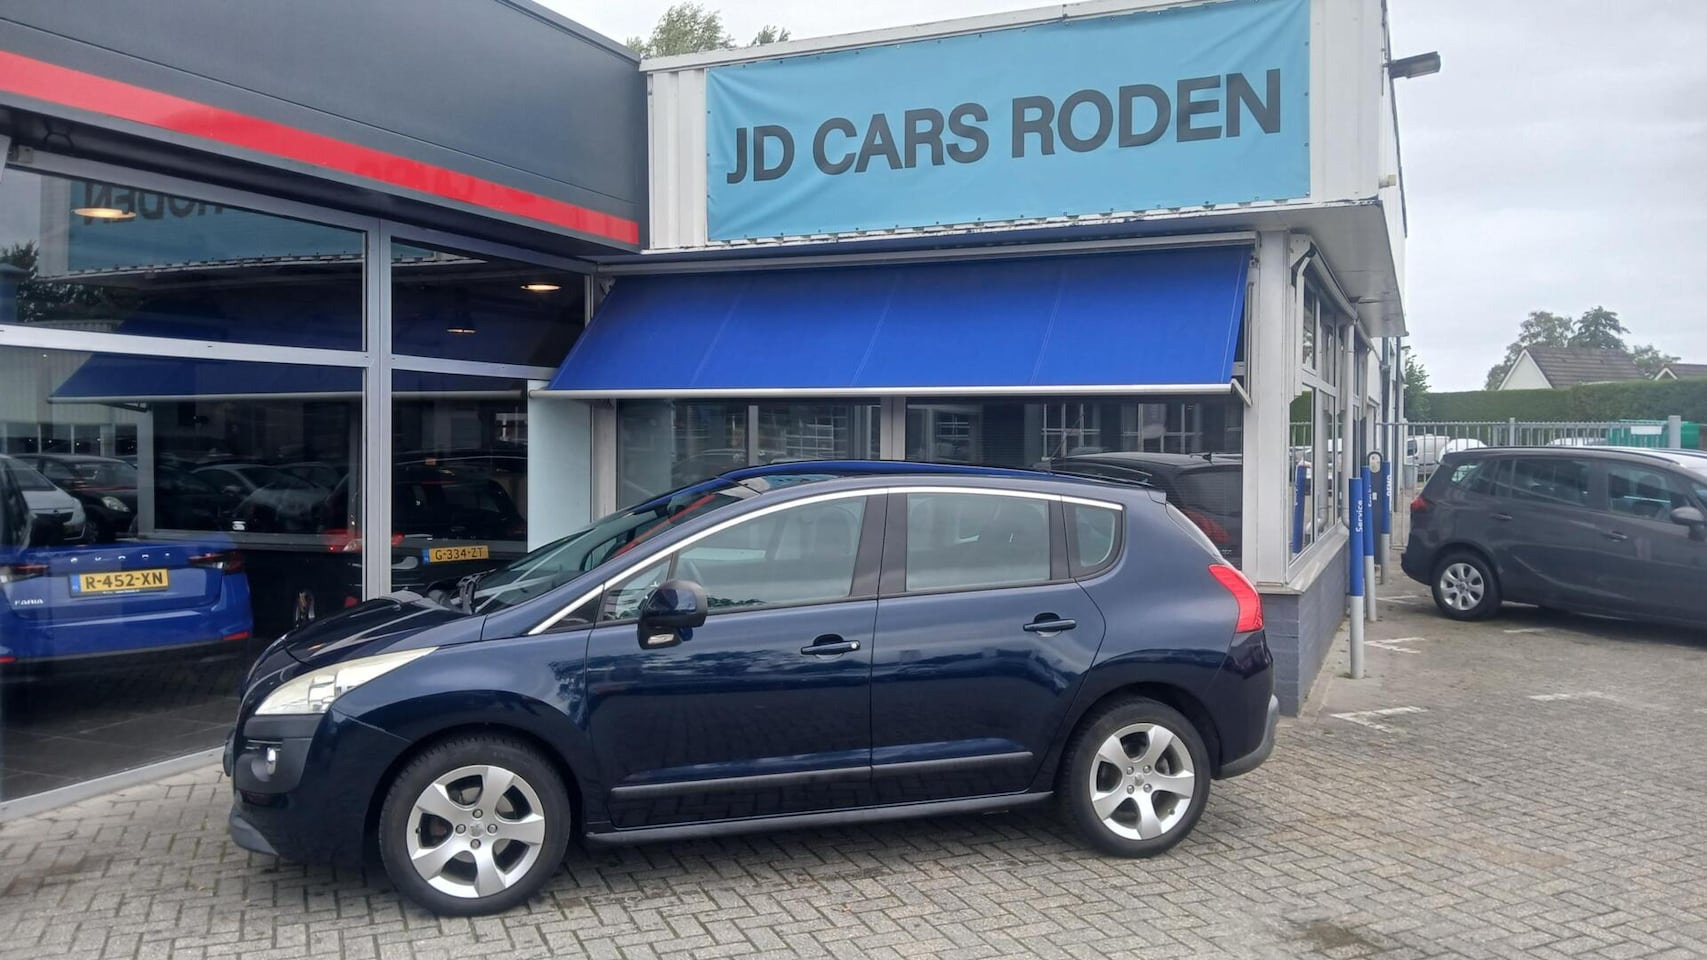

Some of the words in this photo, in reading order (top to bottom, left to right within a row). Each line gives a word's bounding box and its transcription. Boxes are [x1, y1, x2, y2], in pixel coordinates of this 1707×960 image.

[727, 125, 795, 184] JD
[812, 102, 989, 175] CARS
[1012, 68, 1281, 158] RODEN
[1355, 500, 1363, 532] Service
[435, 547, 483, 560] G-334-ZT
[85, 571, 163, 590] R-452-XN
